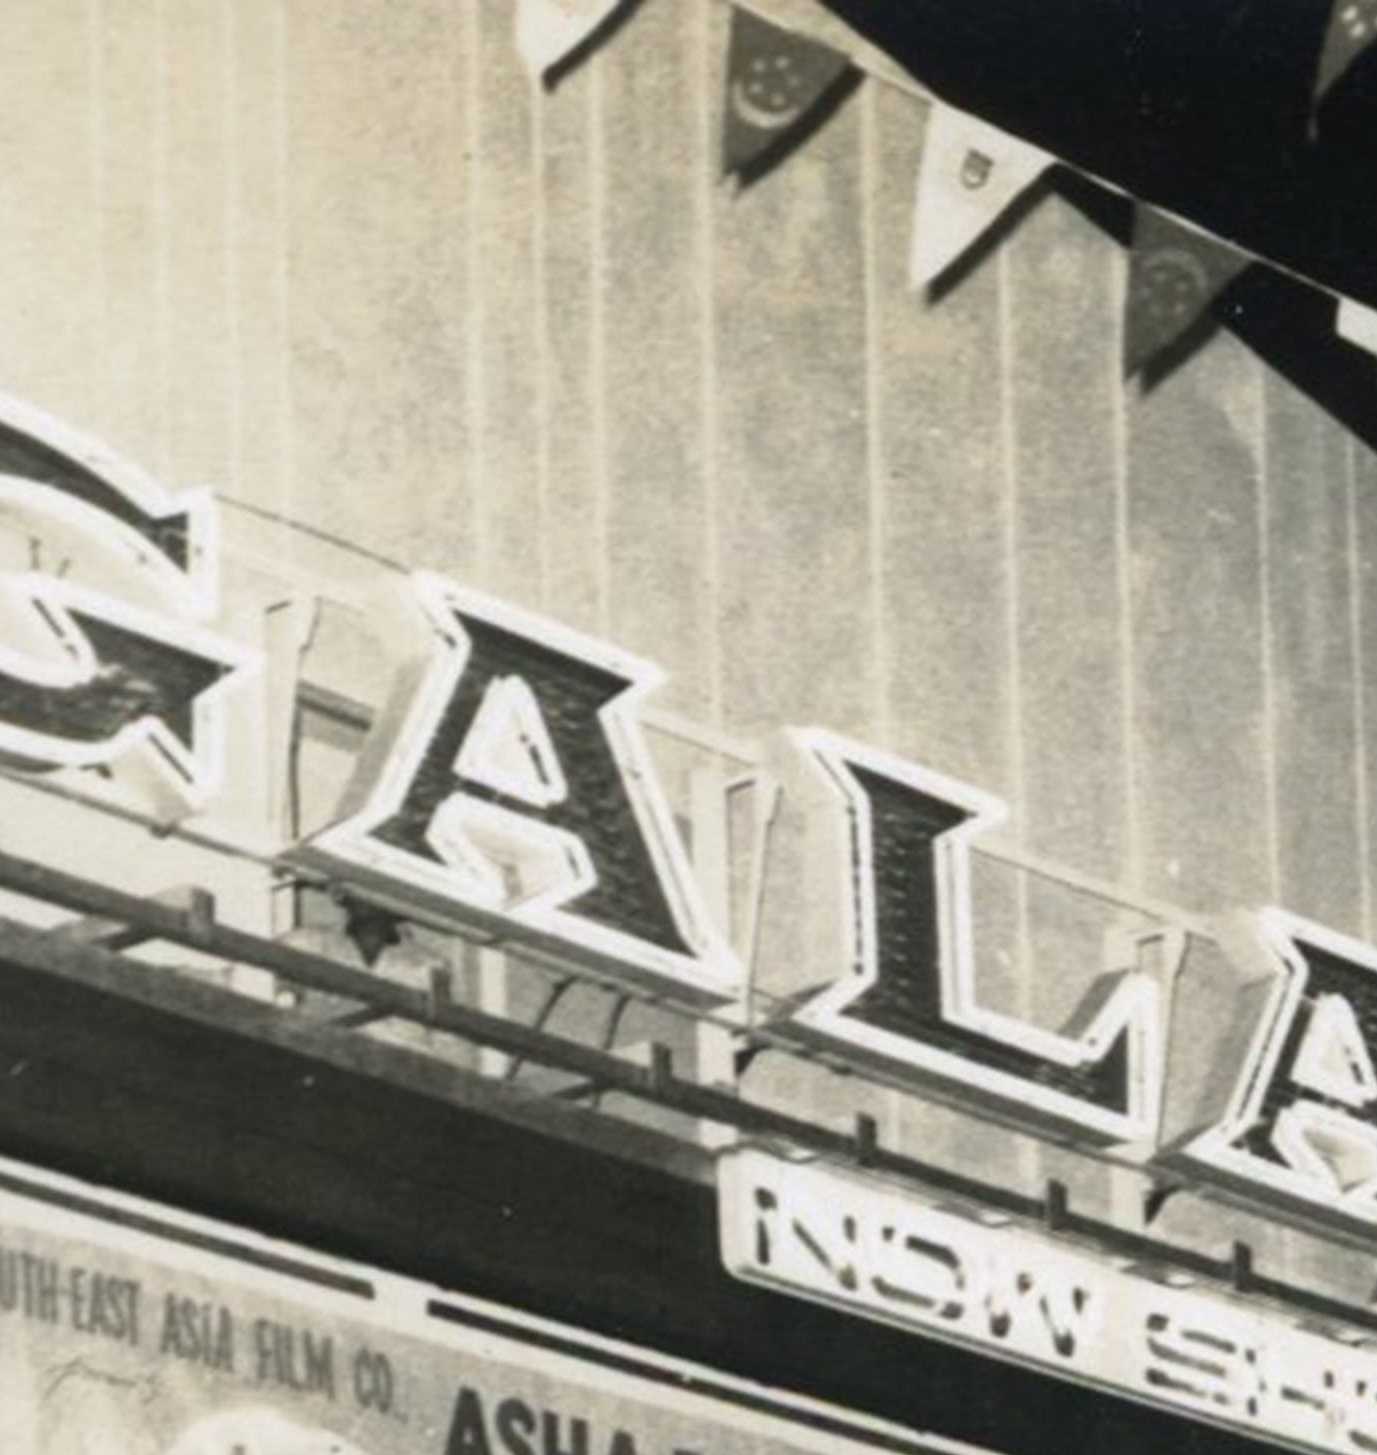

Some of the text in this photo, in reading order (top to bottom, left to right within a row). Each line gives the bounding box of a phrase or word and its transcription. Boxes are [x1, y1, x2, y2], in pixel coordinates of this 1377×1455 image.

[752, 1185, 1094, 1358] NOW
[161, 1290, 235, 1375] ASIA
[252, 1316, 337, 1402] FILM
